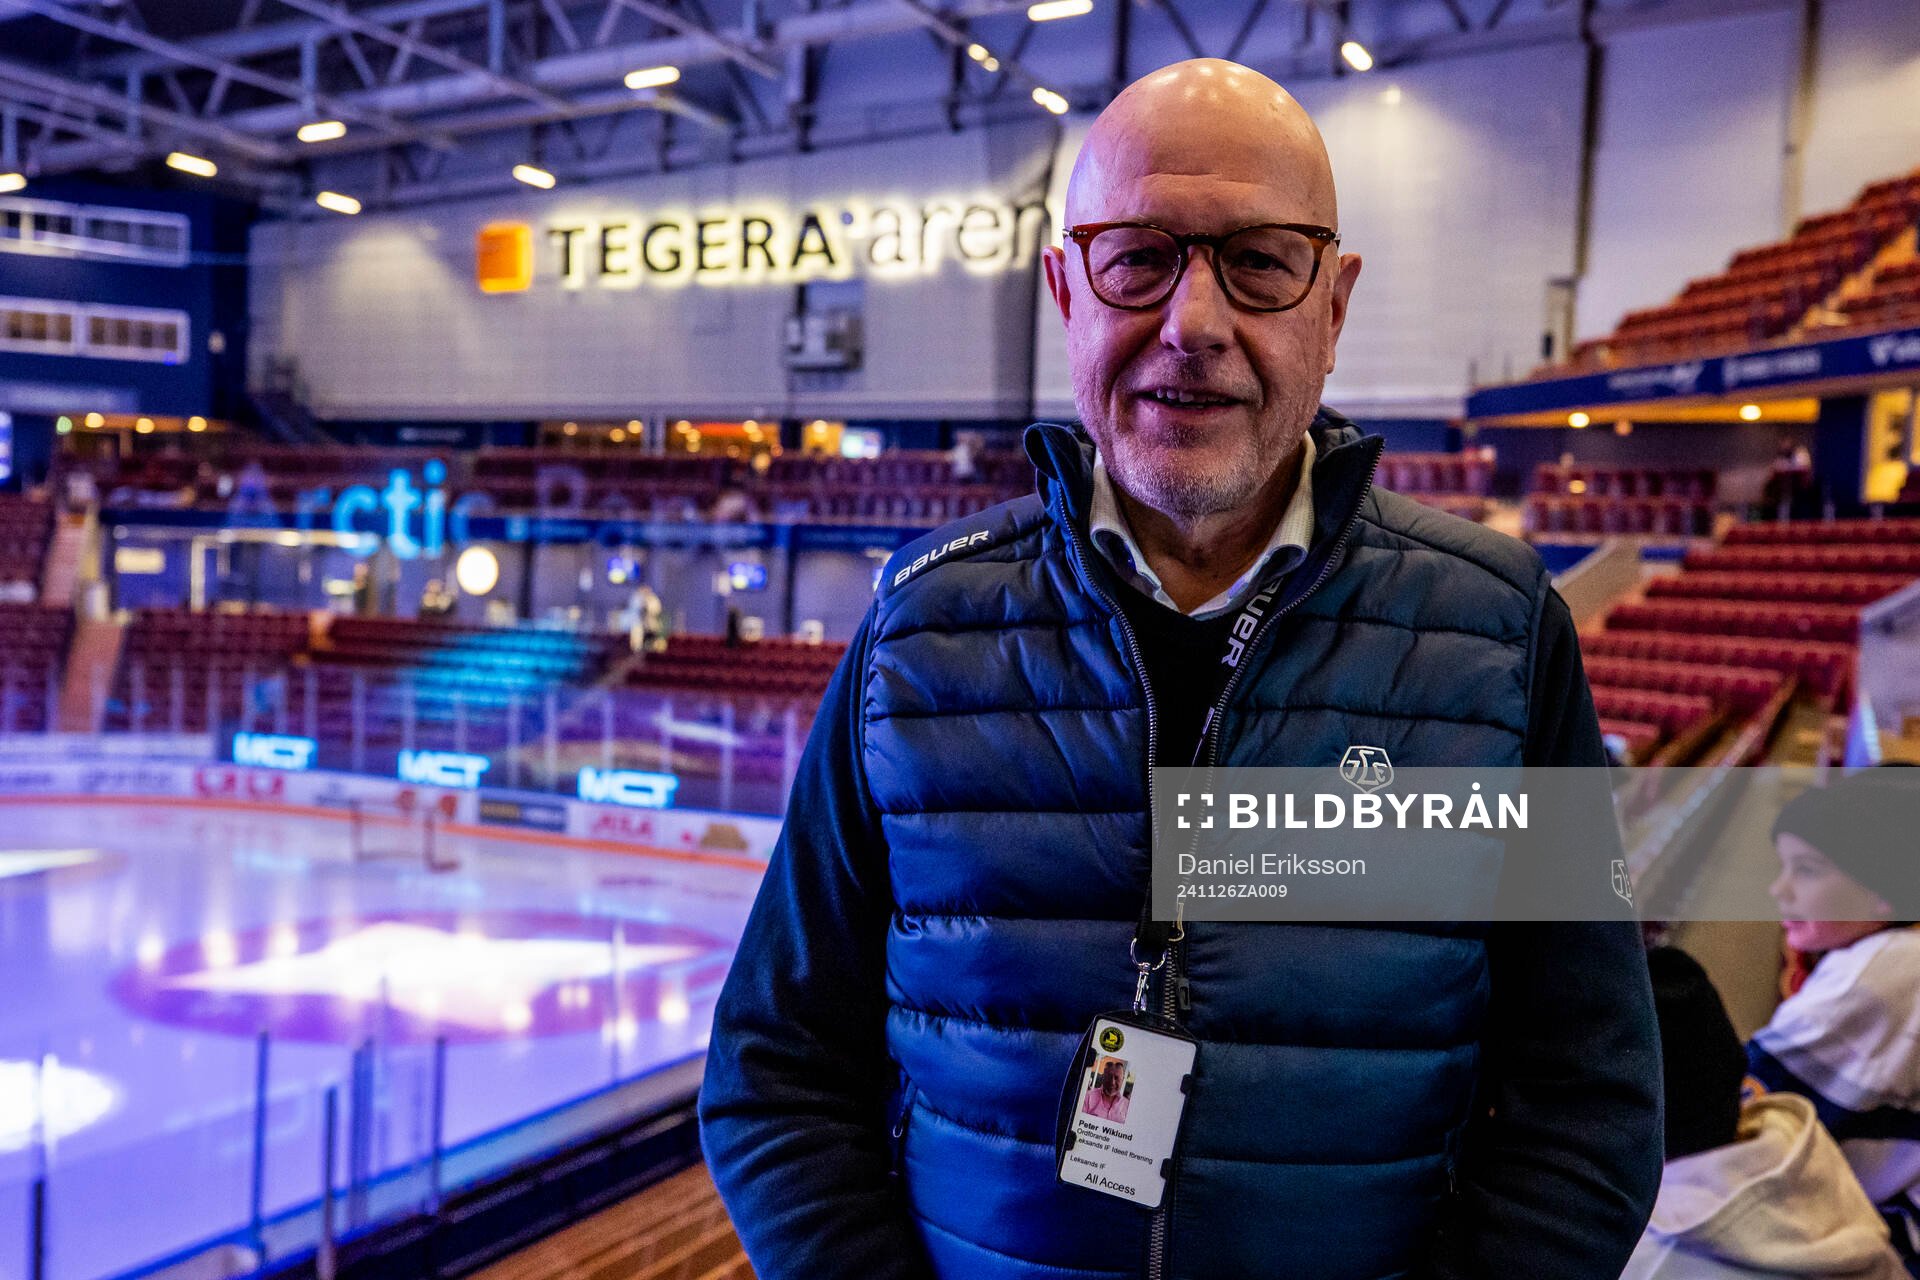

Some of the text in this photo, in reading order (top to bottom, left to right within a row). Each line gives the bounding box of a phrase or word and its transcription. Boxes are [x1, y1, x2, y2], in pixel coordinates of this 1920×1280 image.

[547, 202, 1048, 279] TEGERA aren
[894, 530, 989, 587] BAUER
[1221, 577, 1283, 667] AUER
[1075, 1136, 1103, 1150] eksands
[1078, 1119, 1133, 1142] Peter Wiklund
[1084, 1172, 1136, 1196] All Access
